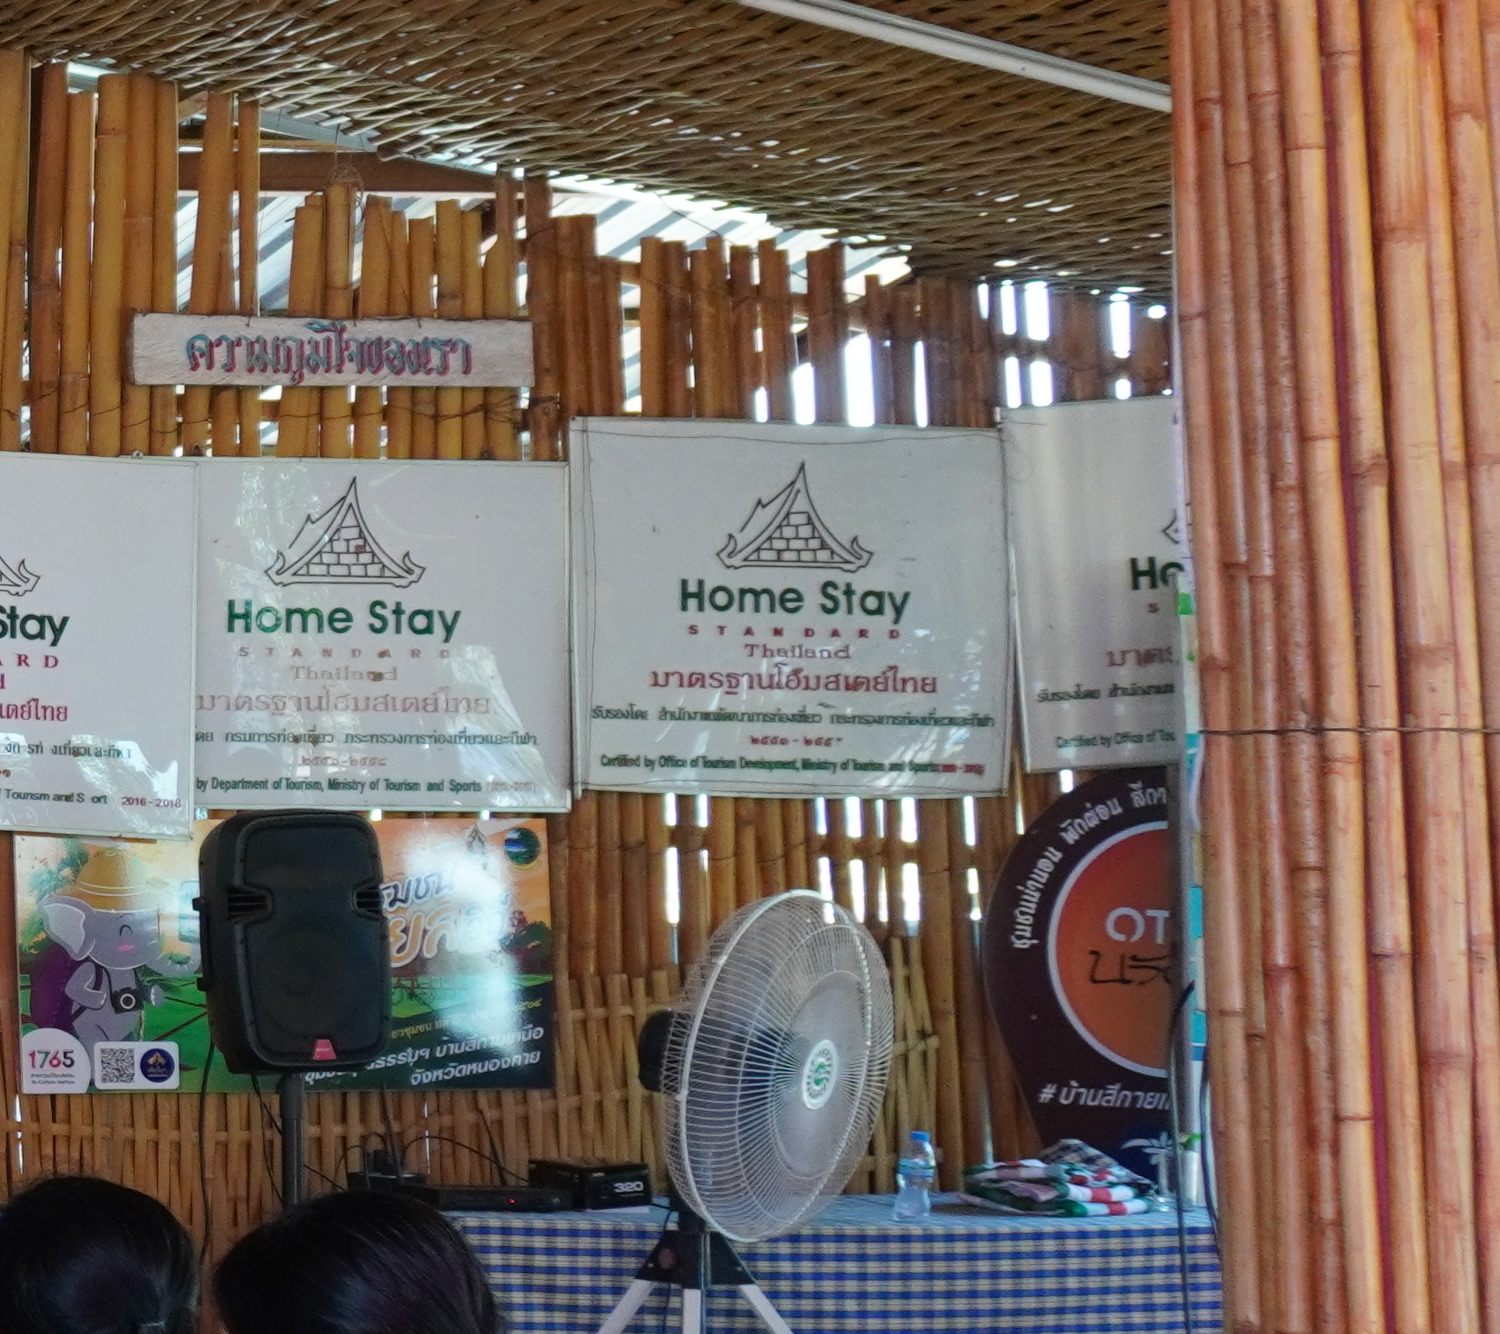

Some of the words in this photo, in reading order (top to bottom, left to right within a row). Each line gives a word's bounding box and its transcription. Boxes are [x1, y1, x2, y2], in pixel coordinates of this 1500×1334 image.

[680, 579, 804, 614] Home
[821, 581, 911, 624] Stay
[227, 599, 354, 634] Home
[368, 600, 462, 643] Stay
[689, 625, 900, 639] STANDARD
[239, 646, 450, 659] STANDARD
[745, 643, 851, 660] Thailand
[291, 666, 397, 682] Thailand
[212, 777, 269, 794] Department
[273, 777, 283, 791] of
[328, 777, 366, 794] Ministry
[370, 778, 380, 792] of
[384, 778, 421, 792] Tourism
[427, 778, 445, 792] and
[449, 778, 482, 795] Sports
[1128, 780, 1168, 809] สีกา
[77, 793, 108, 805] Sort
[1105, 906, 1170, 945] OT
[28, 1049, 75, 1069] 1765
[613, 1180, 644, 1194] 320
